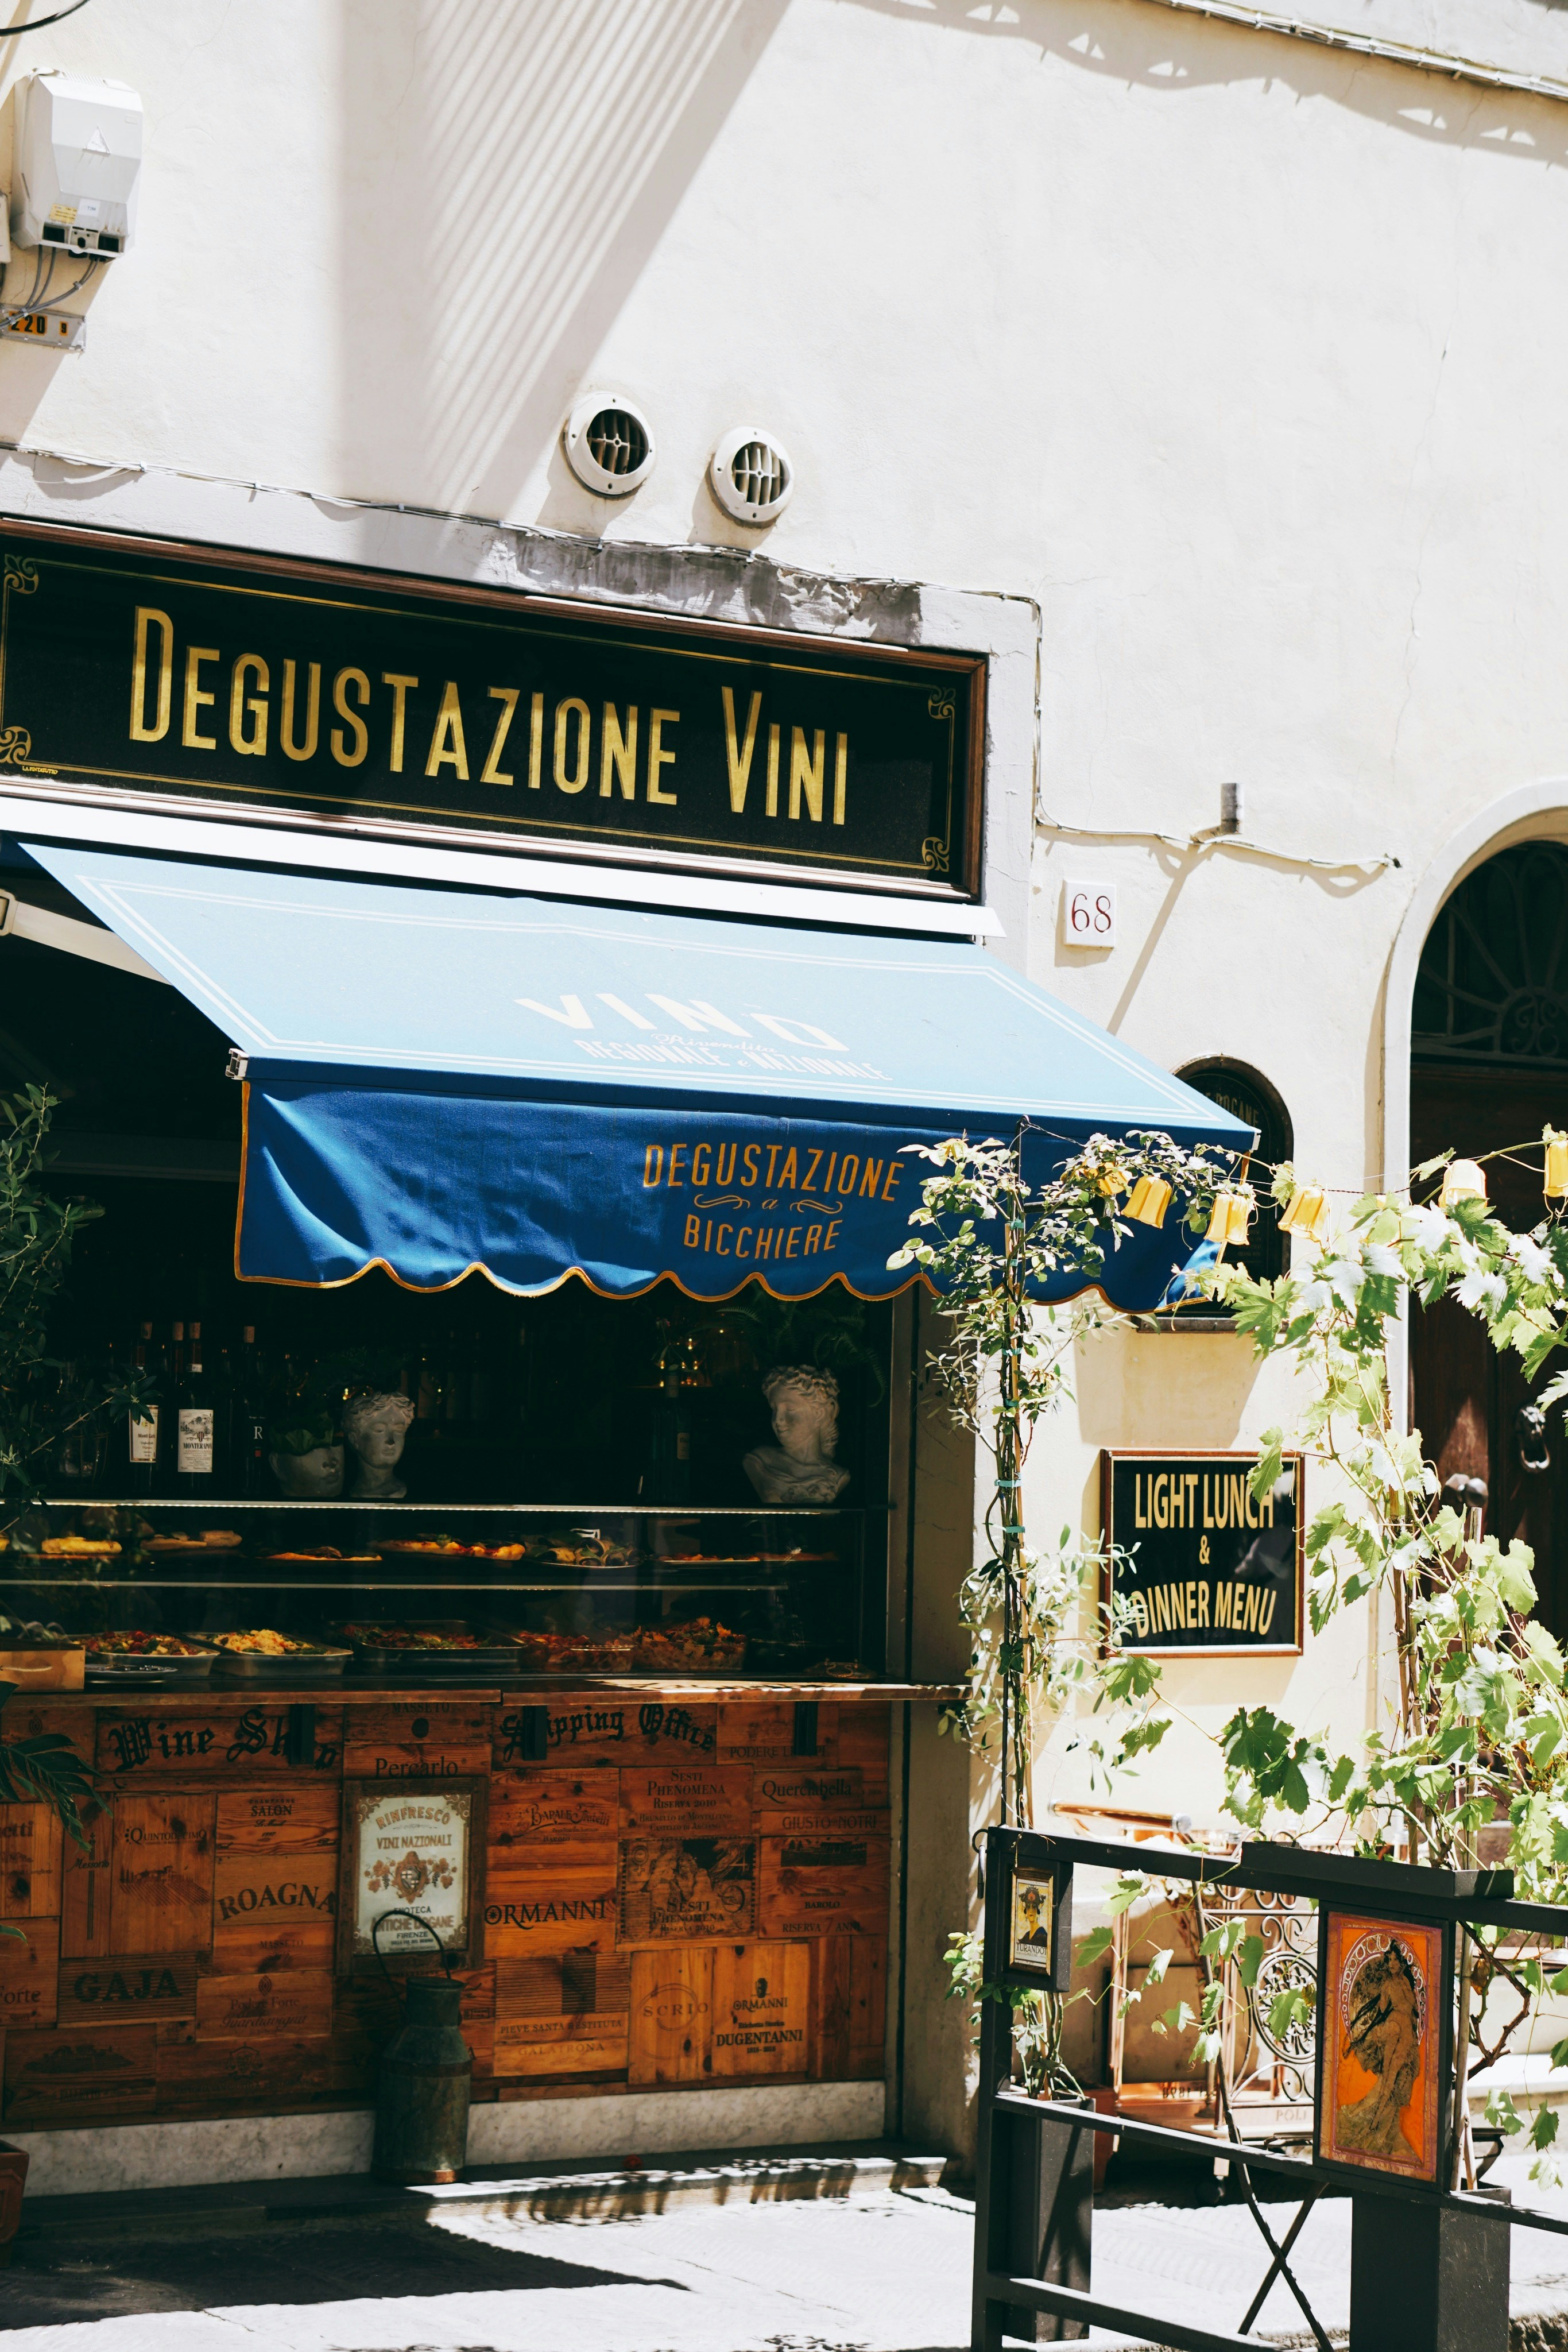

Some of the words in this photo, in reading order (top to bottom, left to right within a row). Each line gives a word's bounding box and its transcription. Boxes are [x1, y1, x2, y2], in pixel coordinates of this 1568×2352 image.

[61, 323, 67, 334] 9
[721, 686, 848, 826] VINI
[1071, 893, 1112, 933] 68
[514, 993, 850, 1052] VINO
[573, 1039, 731, 1067] REGIONALE
[642, 1143, 905, 1202] DEGUSTAZIONE
[683, 1213, 844, 1260] BICCHIERE
[1135, 1473, 1199, 1529] LIGHT
[1203, 1473, 1274, 1529] LUNCH
[1199, 1534, 1210, 1565] &
[1131, 1580, 1210, 1638] DINNER
[1214, 1581, 1277, 1636] MENU
[108, 1716, 215, 1772] Wine
[226, 1708, 340, 1771] Shp
[499, 1705, 625, 1763] Sipping
[375, 1755, 458, 1779] Percarlo
[671, 1768, 703, 1782] SESTI
[647, 1781, 726, 1796] PHENOMENA
[762, 1778, 852, 1804] Querciabella
[250, 1805, 293, 1817] SALON
[653, 1797, 690, 1809] RISERVA
[694, 1800, 717, 1808] 2010
[375, 1806, 451, 1831] RINFRESCO
[639, 1813, 676, 1823] BRUNELLO
[782, 1815, 831, 1830] GIUSTO
[838, 1814, 877, 1829] NOTRI
[0, 1820, 33, 1838] etti
[377, 1836, 400, 1850] VINI
[402, 1833, 452, 1848] NAZIONALI
[216, 1882, 336, 1921] ROAGNA
[666, 1896, 711, 1913] SESTI
[804, 1901, 841, 1909] BAROLO
[484, 1900, 607, 1930] ORMANNI
[651, 1911, 725, 1924] PHENOMENA
[396, 1931, 428, 1939] FIRENZE
[782, 1922, 822, 1933] RISERVA
[1016, 1943, 1047, 1956] TURANDOT
[73, 1968, 184, 2003] GAJA
[271, 1996, 300, 2008] Forte
[642, 2002, 708, 2017] SCRIO
[733, 1997, 788, 2013] ORMANNI
[501, 2024, 530, 2034] PIEVE
[532, 2022, 564, 2033] SANTA
[715, 2029, 804, 2047] DUGENTANNI
